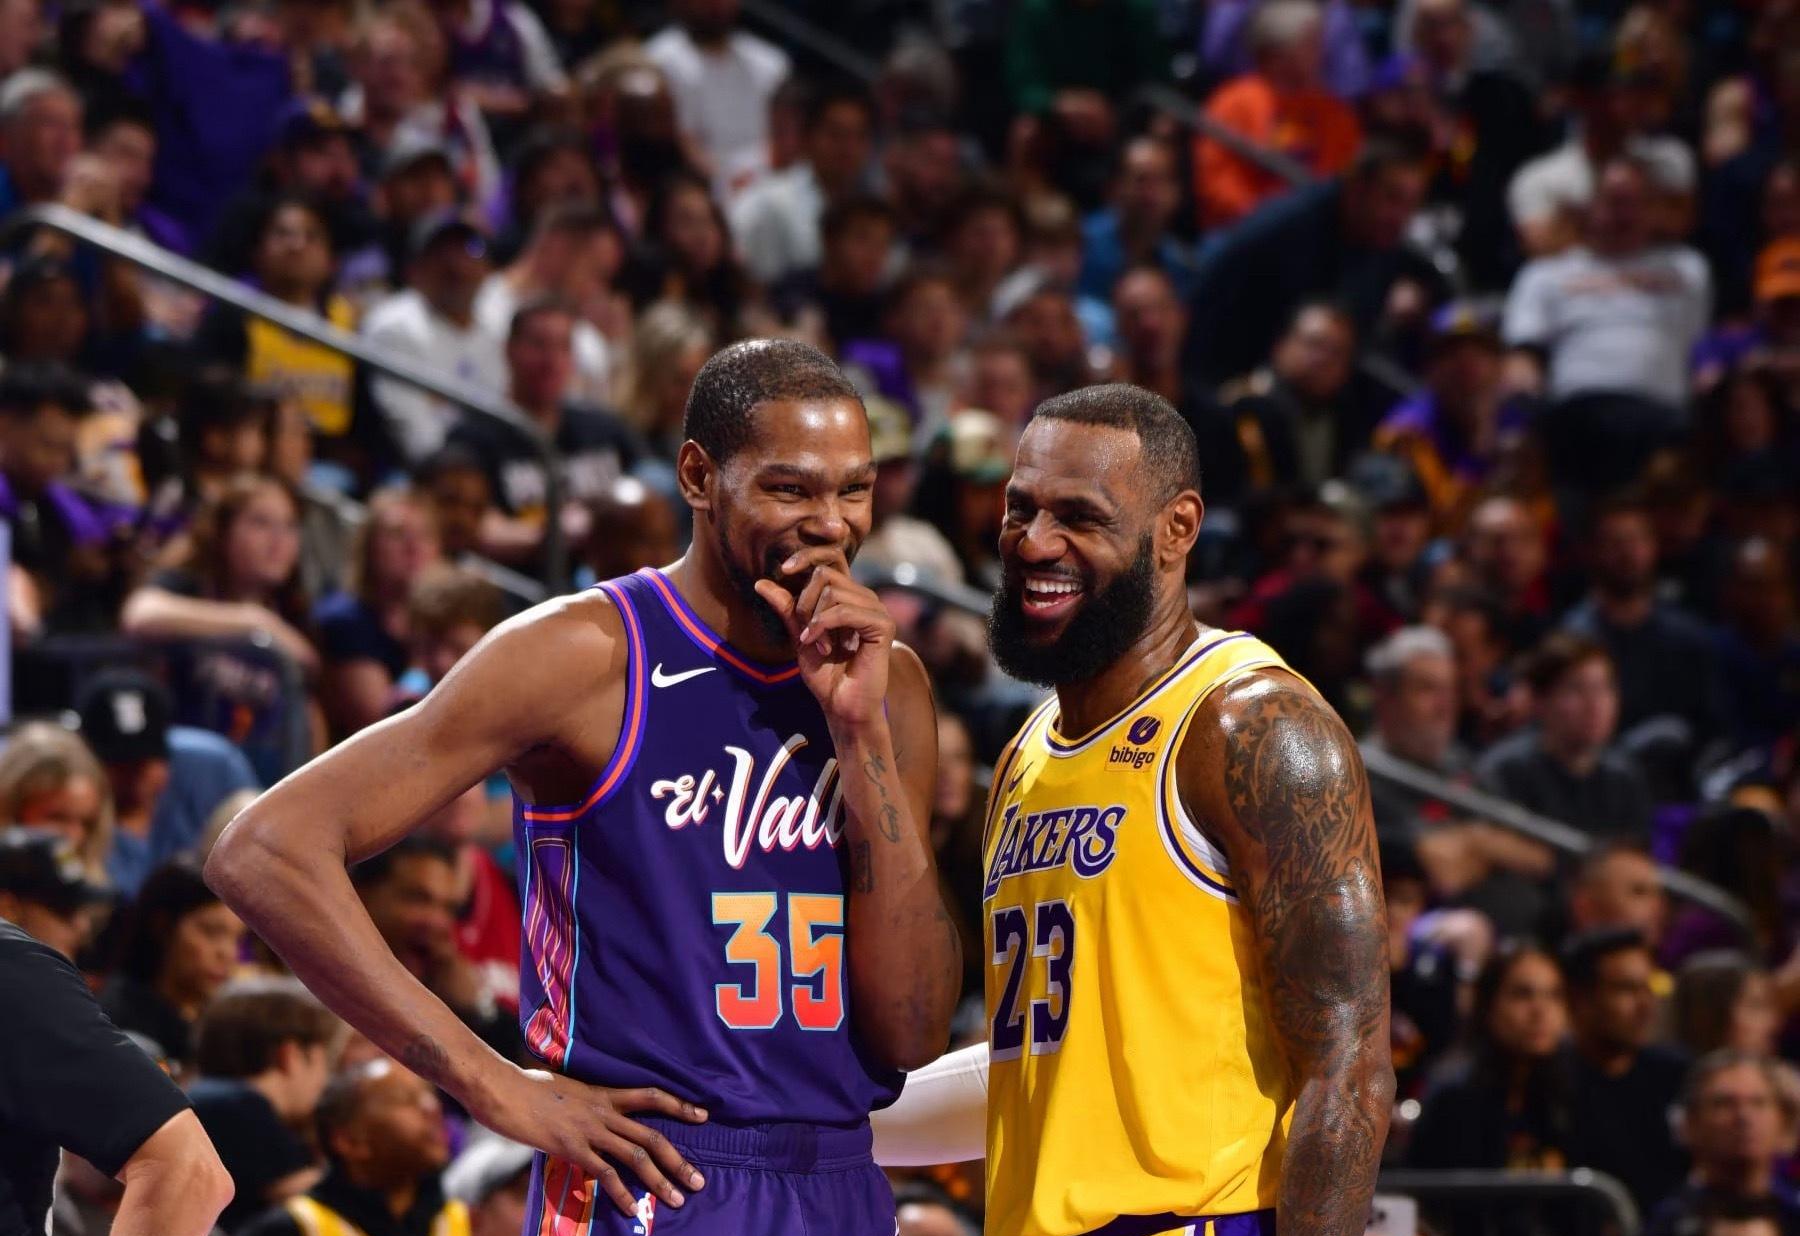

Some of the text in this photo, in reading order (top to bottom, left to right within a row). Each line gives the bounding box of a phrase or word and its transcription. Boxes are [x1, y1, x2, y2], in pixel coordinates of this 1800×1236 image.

[651, 769, 716, 830] El
[723, 733, 844, 870] Vall
[1109, 745, 1155, 769] bibigo
[983, 801, 1127, 902] LAKERS
[711, 892, 845, 1031] 35
[990, 899, 1076, 1062] 23
